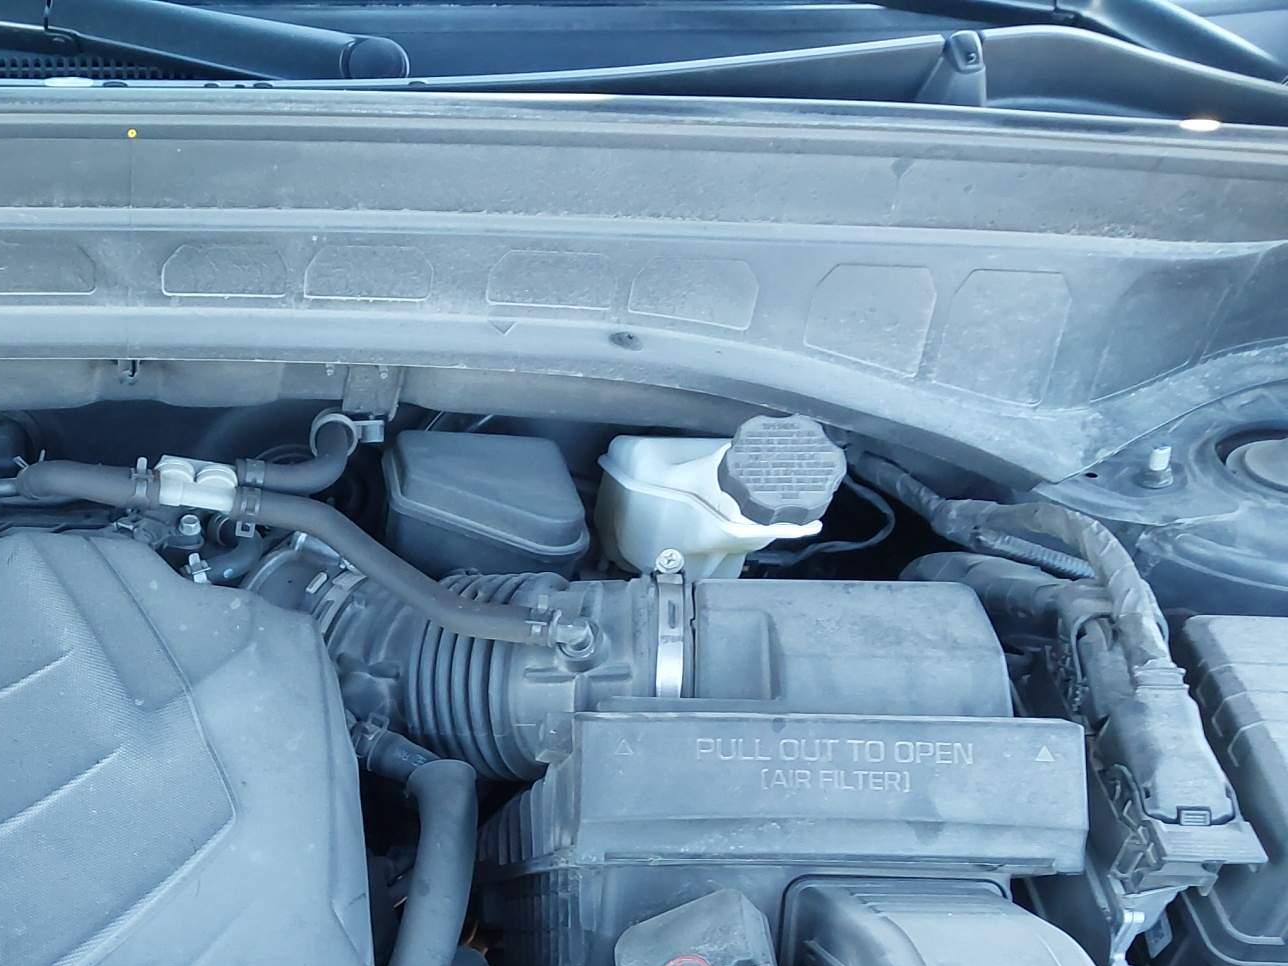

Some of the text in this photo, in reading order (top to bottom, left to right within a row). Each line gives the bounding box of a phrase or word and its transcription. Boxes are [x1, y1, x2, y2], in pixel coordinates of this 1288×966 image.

[696, 737, 975, 765] PULL OUT TO OPEN
